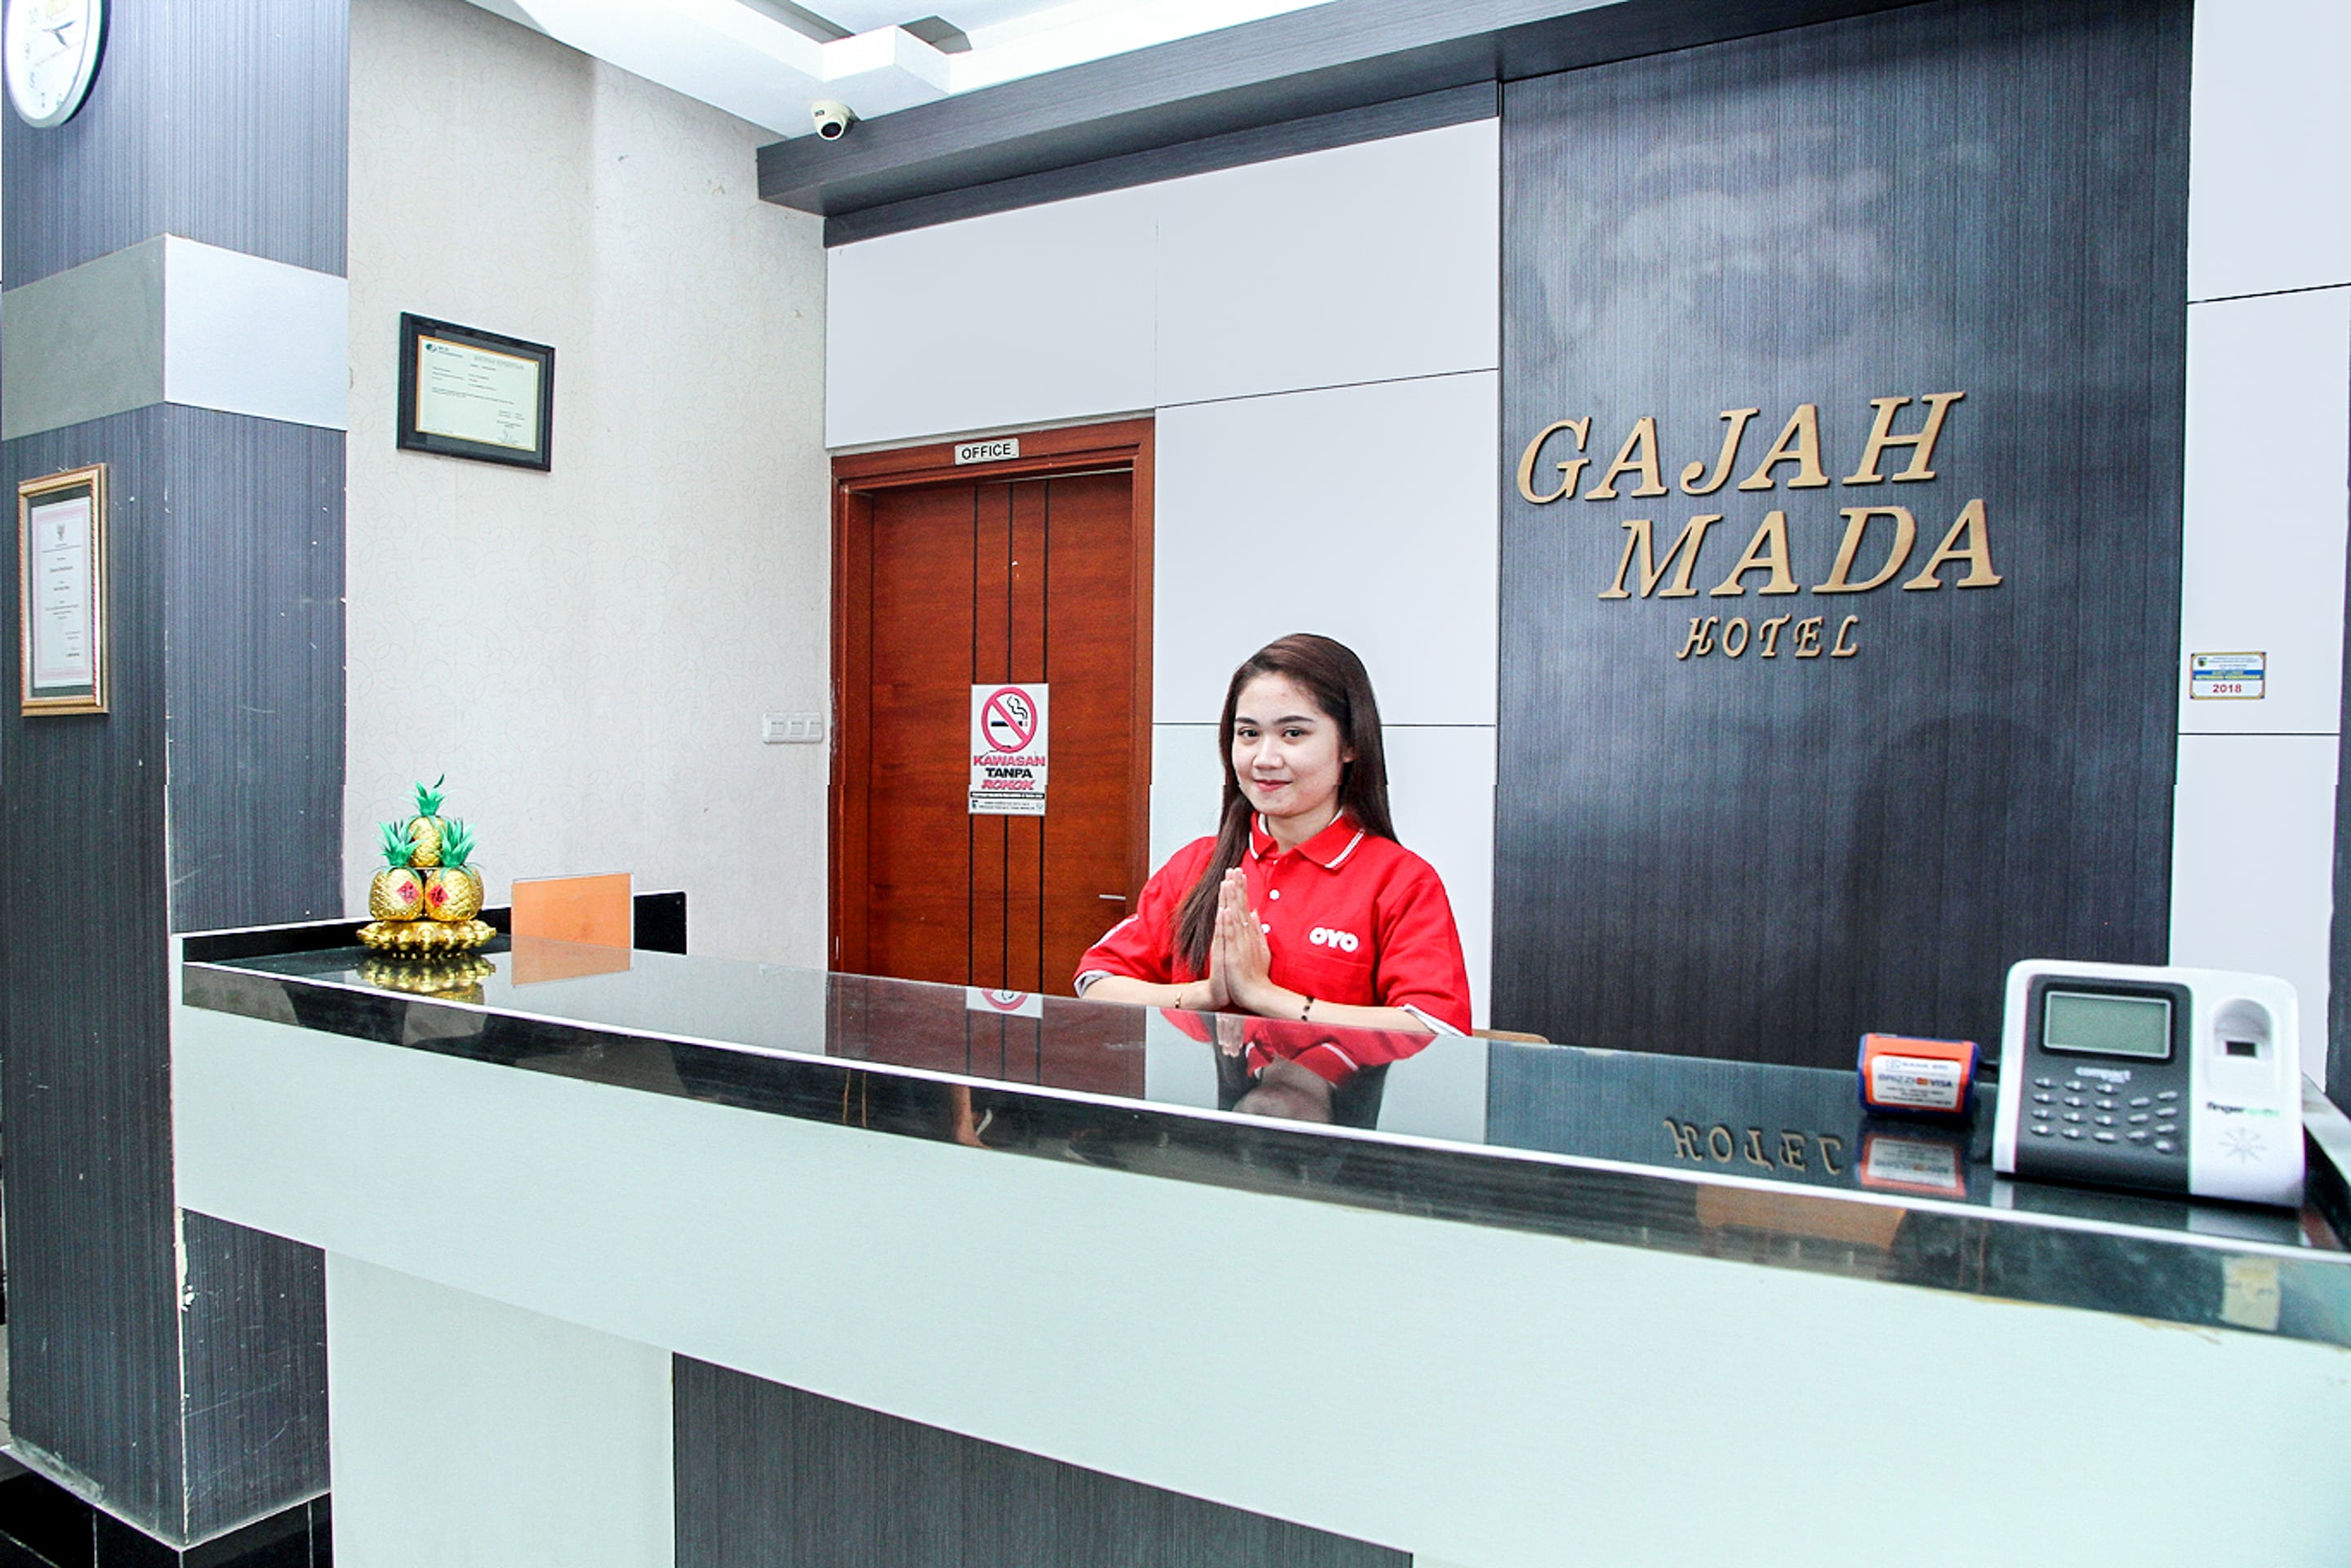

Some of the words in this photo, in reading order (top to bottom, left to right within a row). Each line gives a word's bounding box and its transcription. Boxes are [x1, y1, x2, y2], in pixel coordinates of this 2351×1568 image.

[961, 443, 1011, 460] OFFICE
[1516, 391, 1966, 505] GAJAH
[1597, 498, 2003, 599] MADA
[1676, 613, 1860, 660] HOTEL
[2212, 684, 2242, 693] 2018
[973, 755, 1045, 766] KAWASAN
[985, 768, 1033, 778] TANPA
[982, 780, 1035, 790] ROKOK
[1308, 926, 1359, 953] OYO
